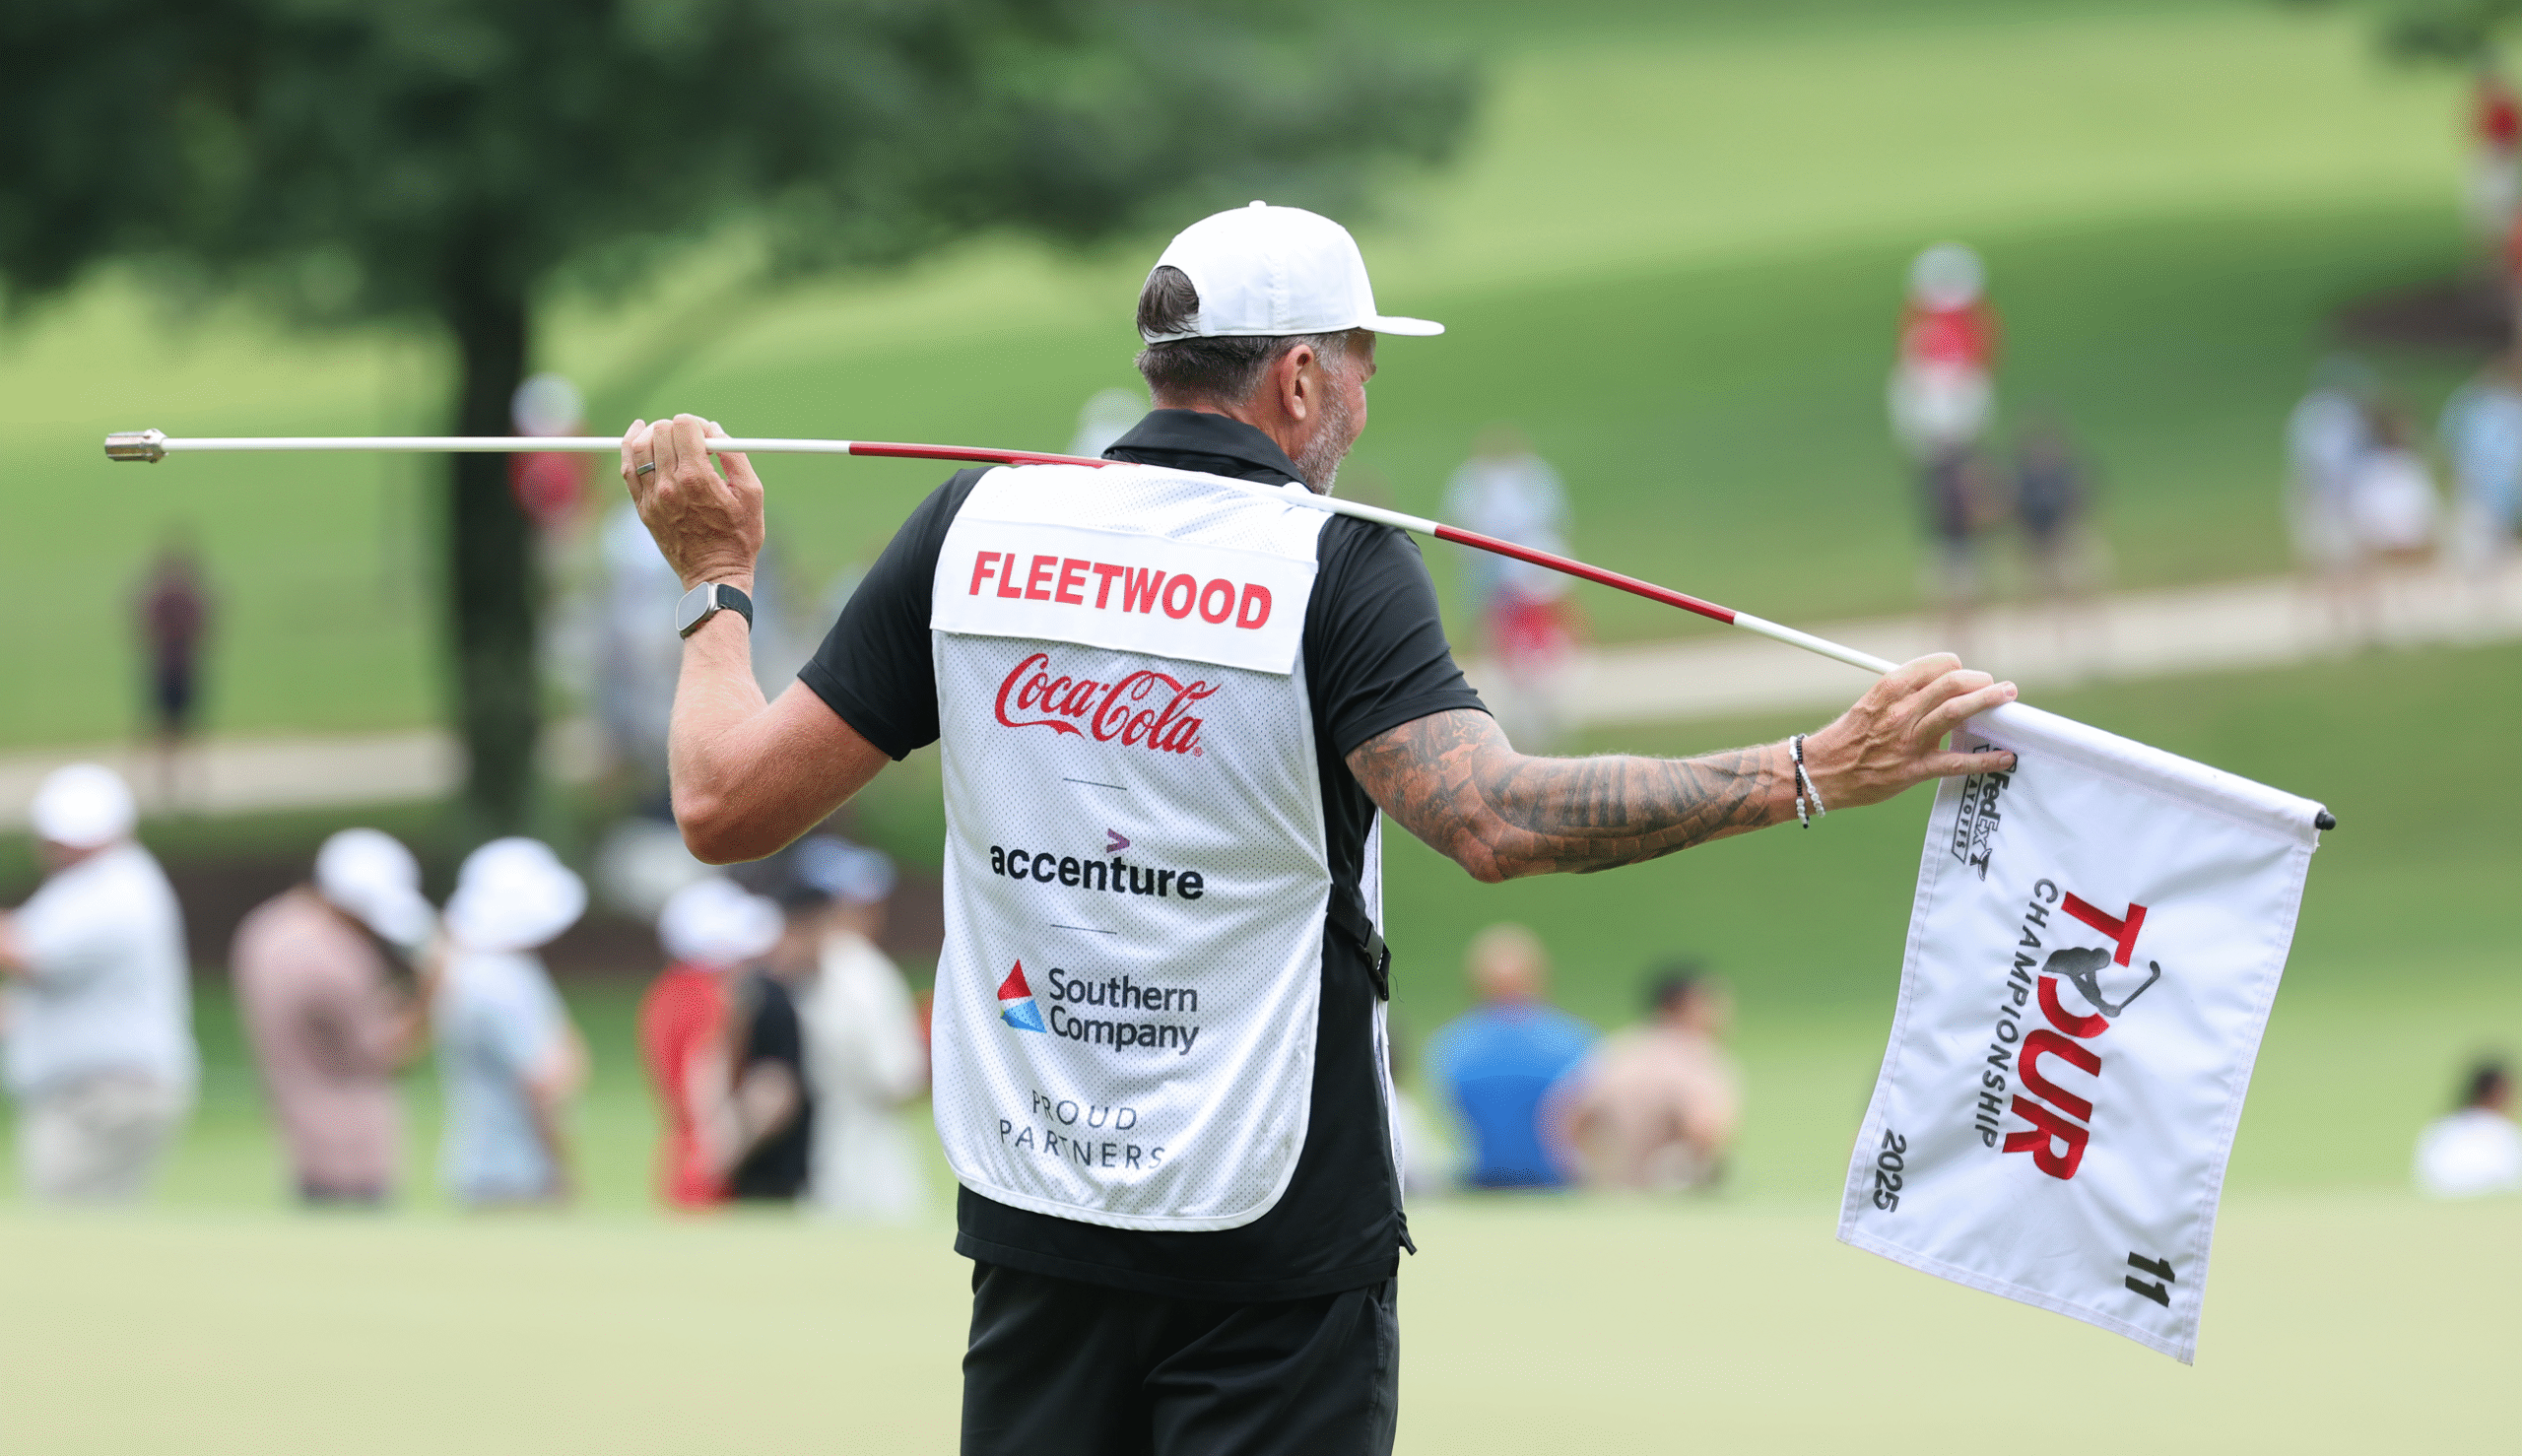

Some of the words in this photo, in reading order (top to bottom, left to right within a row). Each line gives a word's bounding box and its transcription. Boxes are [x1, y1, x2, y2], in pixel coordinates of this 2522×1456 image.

[968, 551, 1272, 629] FLEETWOOD
[994, 653, 1223, 755] Coca-Cola
[1956, 777, 1978, 849] AYOFFS
[1972, 771, 2011, 849] FedEx
[989, 844, 1205, 900] accenture
[1048, 967, 1198, 1013] Southern
[1974, 878, 2059, 1149] CHAMPIONSHIP
[1050, 1005, 1200, 1056] Company
[2002, 891, 2148, 1180] TOUR
[999, 1119, 1165, 1170] PARTNERS
[1031, 1089, 1137, 1131] PROUD
[1872, 1128, 1907, 1213] 2025
[2124, 1251, 2176, 1308] 11
